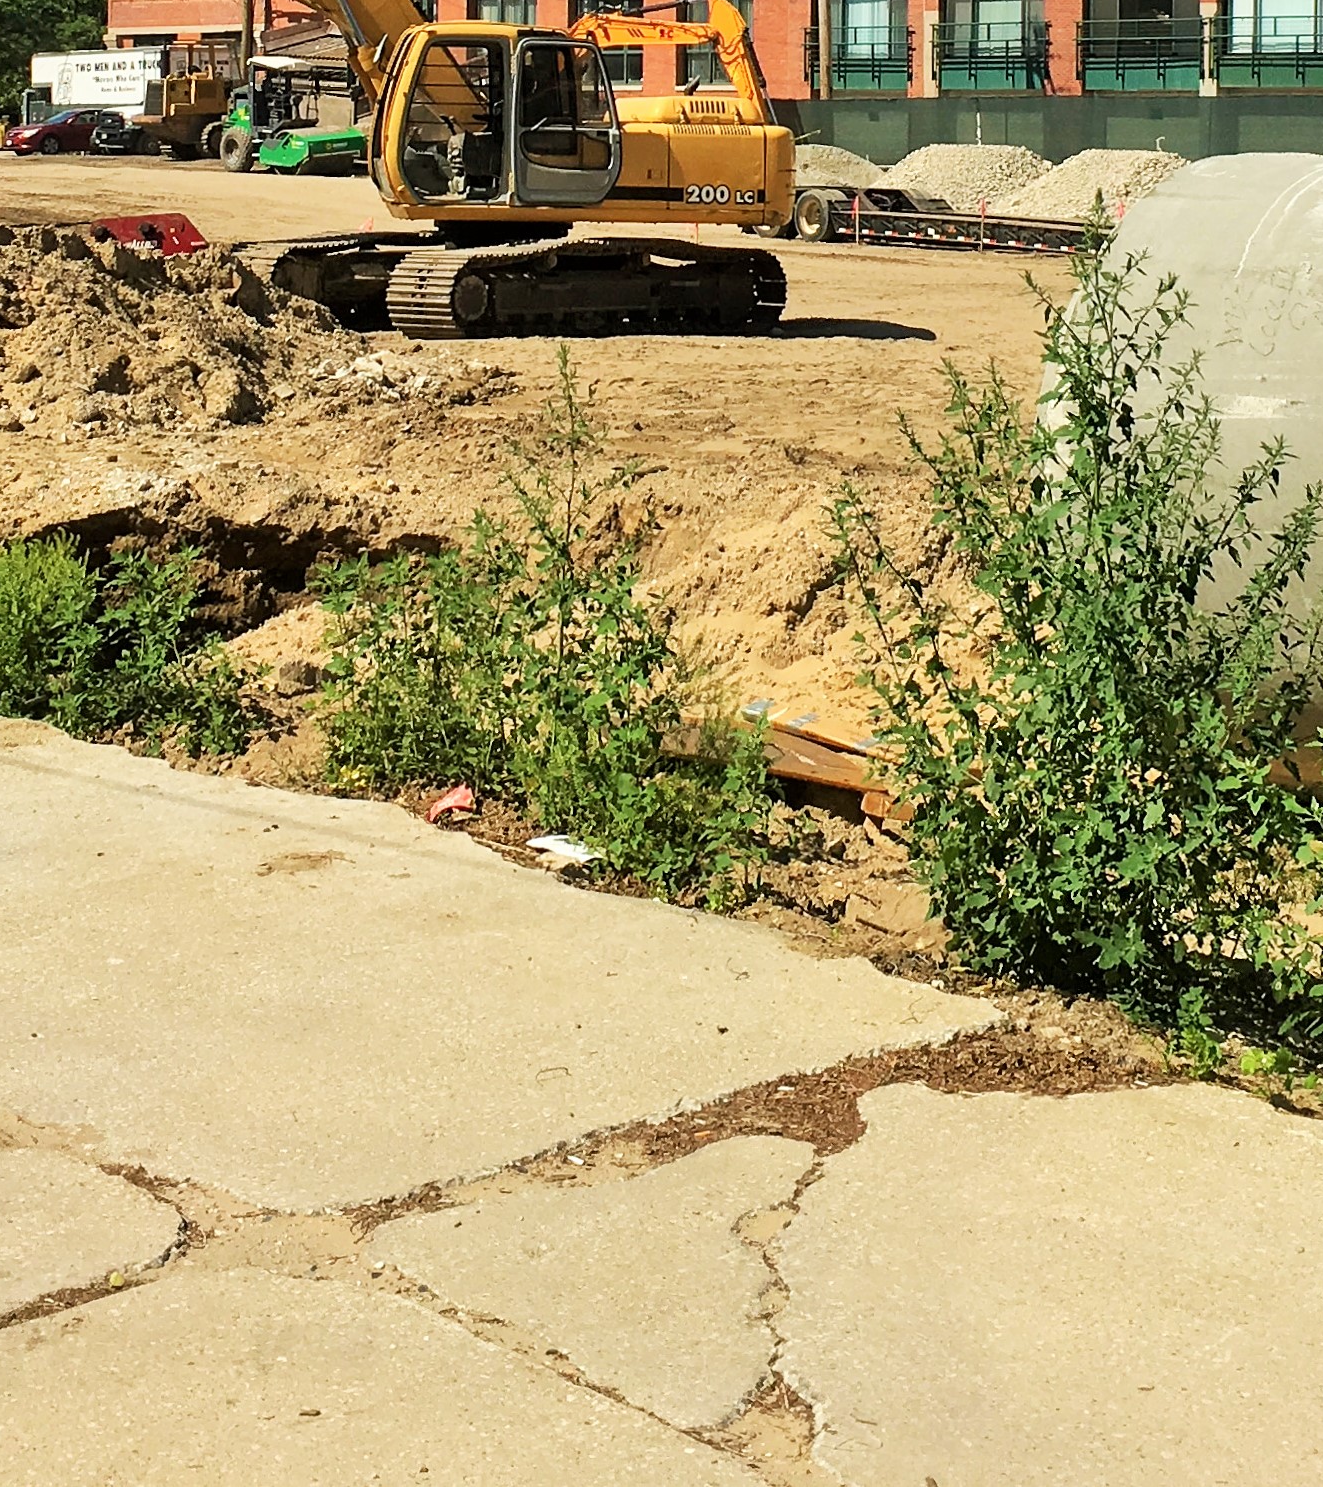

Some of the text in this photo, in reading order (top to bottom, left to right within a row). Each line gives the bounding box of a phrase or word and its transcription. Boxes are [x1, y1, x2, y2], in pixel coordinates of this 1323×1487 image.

[75, 63, 92, 72] TWO
[94, 62, 109, 72] MEN
[112, 61, 127, 71] AND
[686, 184, 754, 204] 200 LC
